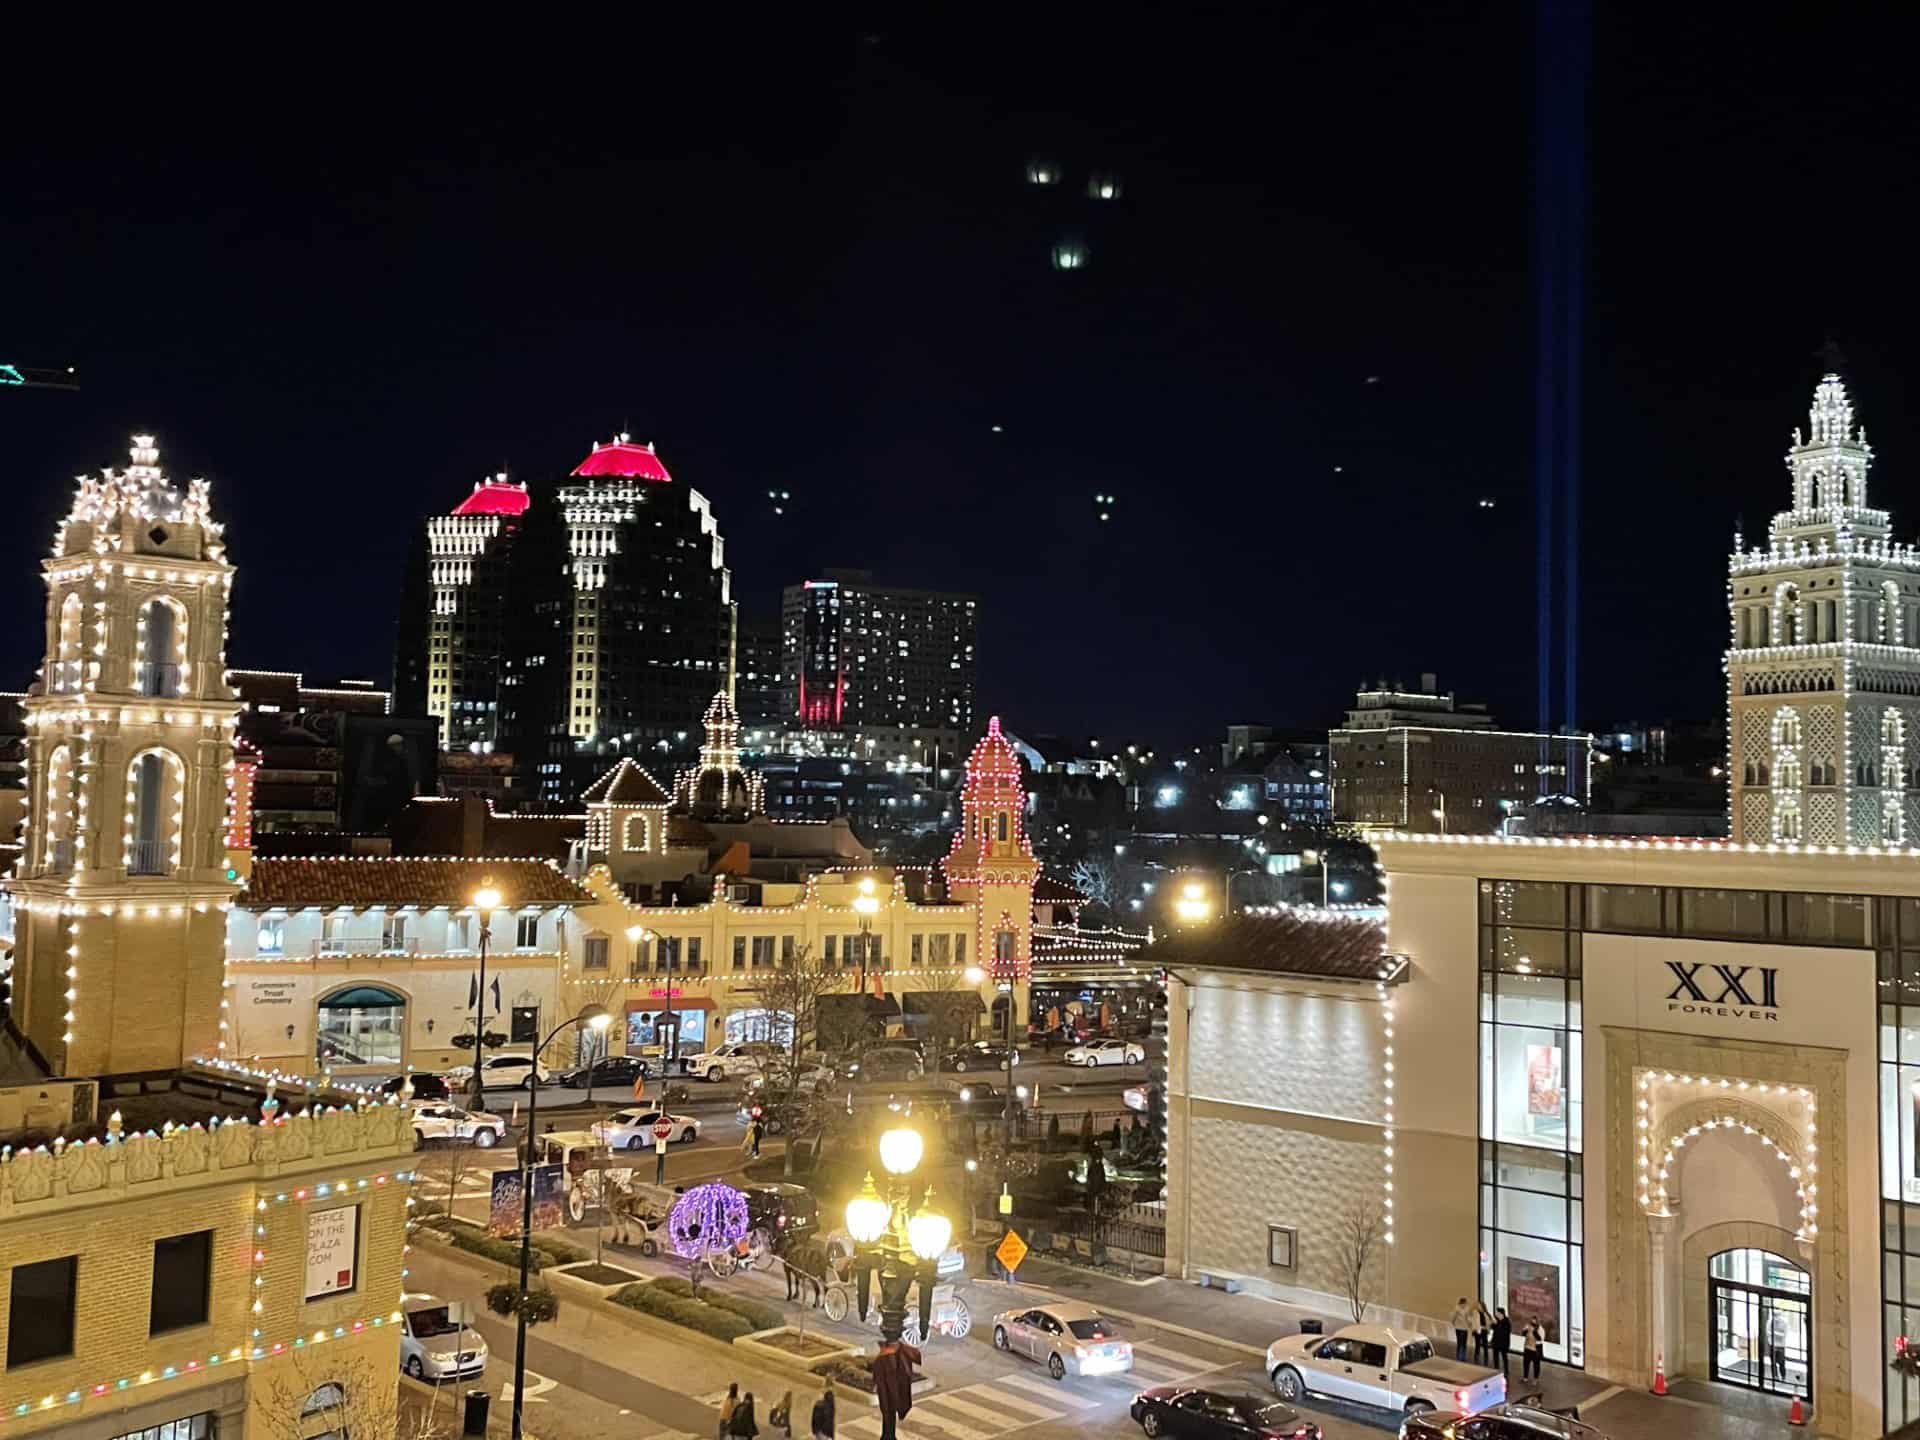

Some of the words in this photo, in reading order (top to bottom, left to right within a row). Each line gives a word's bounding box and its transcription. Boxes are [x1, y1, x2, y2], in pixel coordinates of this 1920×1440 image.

[1664, 961, 1779, 1008] XXI
[1668, 1003, 1778, 1021] FOREVER
[327, 1225, 345, 1237] THE
